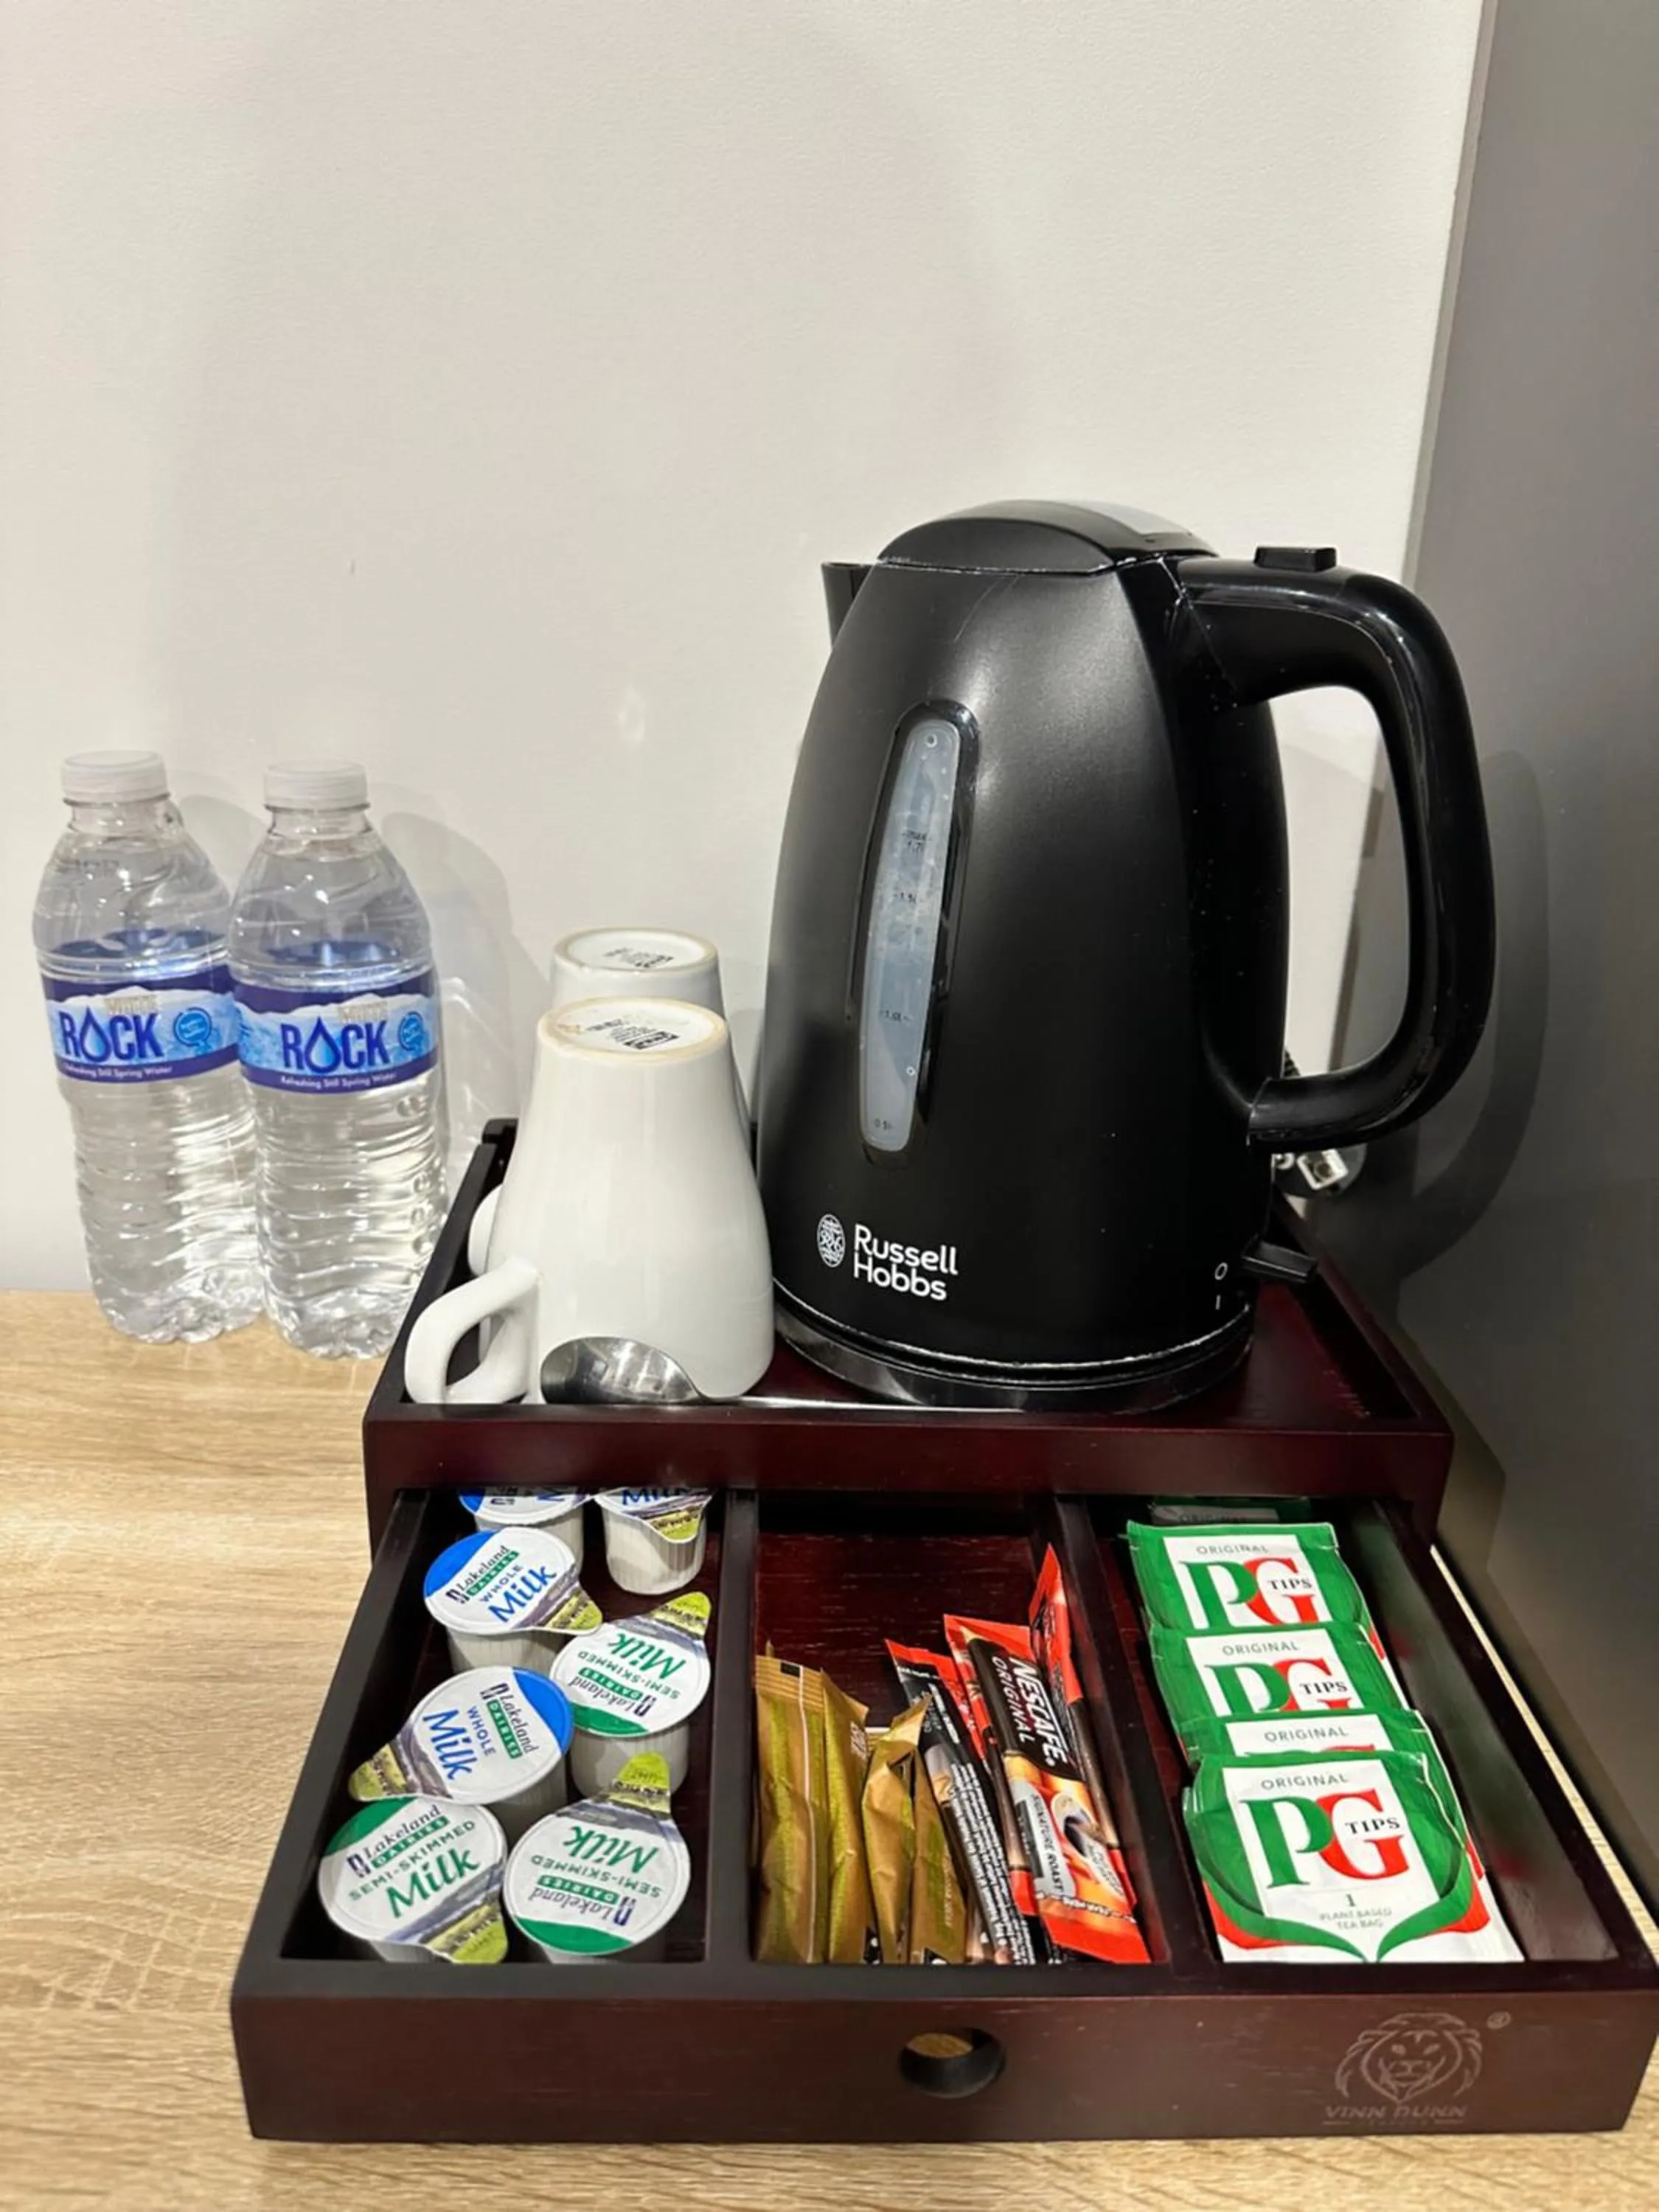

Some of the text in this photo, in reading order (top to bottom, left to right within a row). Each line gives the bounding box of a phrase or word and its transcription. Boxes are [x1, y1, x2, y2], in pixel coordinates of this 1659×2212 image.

[59, 1004, 164, 1062] ROCK
[280, 1015, 390, 1074] ROCK
[854, 1222, 959, 1276] Russell
[853, 1251, 947, 1301] Hobbs
[457, 1545, 512, 1590] Lakeland
[1196, 1544, 1269, 1556] ORIGINAL
[479, 1564, 524, 1603] WHOLE
[487, 1565, 557, 1623] Milk
[1178, 1557, 1320, 1628] PG
[1267, 1576, 1313, 1590] TIPS
[608, 1632, 687, 1680] Milk
[1222, 1641, 1301, 1656] ORIGINAL
[567, 1675, 637, 1712] Lakeland
[577, 1650, 681, 1700] SEMI-SKIMMED
[1298, 1680, 1349, 1695] TIPS
[991, 1655, 1036, 1744] ORIGINAL
[422, 1708, 478, 1781] Milk
[467, 1705, 497, 1756] WHOLE
[499, 1694, 540, 1756] Lakeland
[1264, 1726, 1349, 1743] ORIGINAL
[1260, 1773, 1351, 1791] ORIGINAL
[363, 1804, 442, 1859] Lakeland
[1239, 1787, 1411, 1889] PG
[1344, 1816, 1401, 1836] TIPS
[348, 1820, 476, 1902] SEMI-SKIMMED
[563, 1825, 659, 1874] Milk
[1047, 1851, 1065, 1893] ROAST
[386, 1848, 480, 1919] Milk
[530, 1854, 663, 1899] SEMI-SKIMMED
[528, 1886, 616, 1920] Lakeland
[1318, 1907, 1393, 1921] PLANT BASED
[1345, 1893, 1357, 1908] 1
[1337, 1918, 1384, 1930] TEA BAG
[1325, 2104, 1388, 2120] VINN
